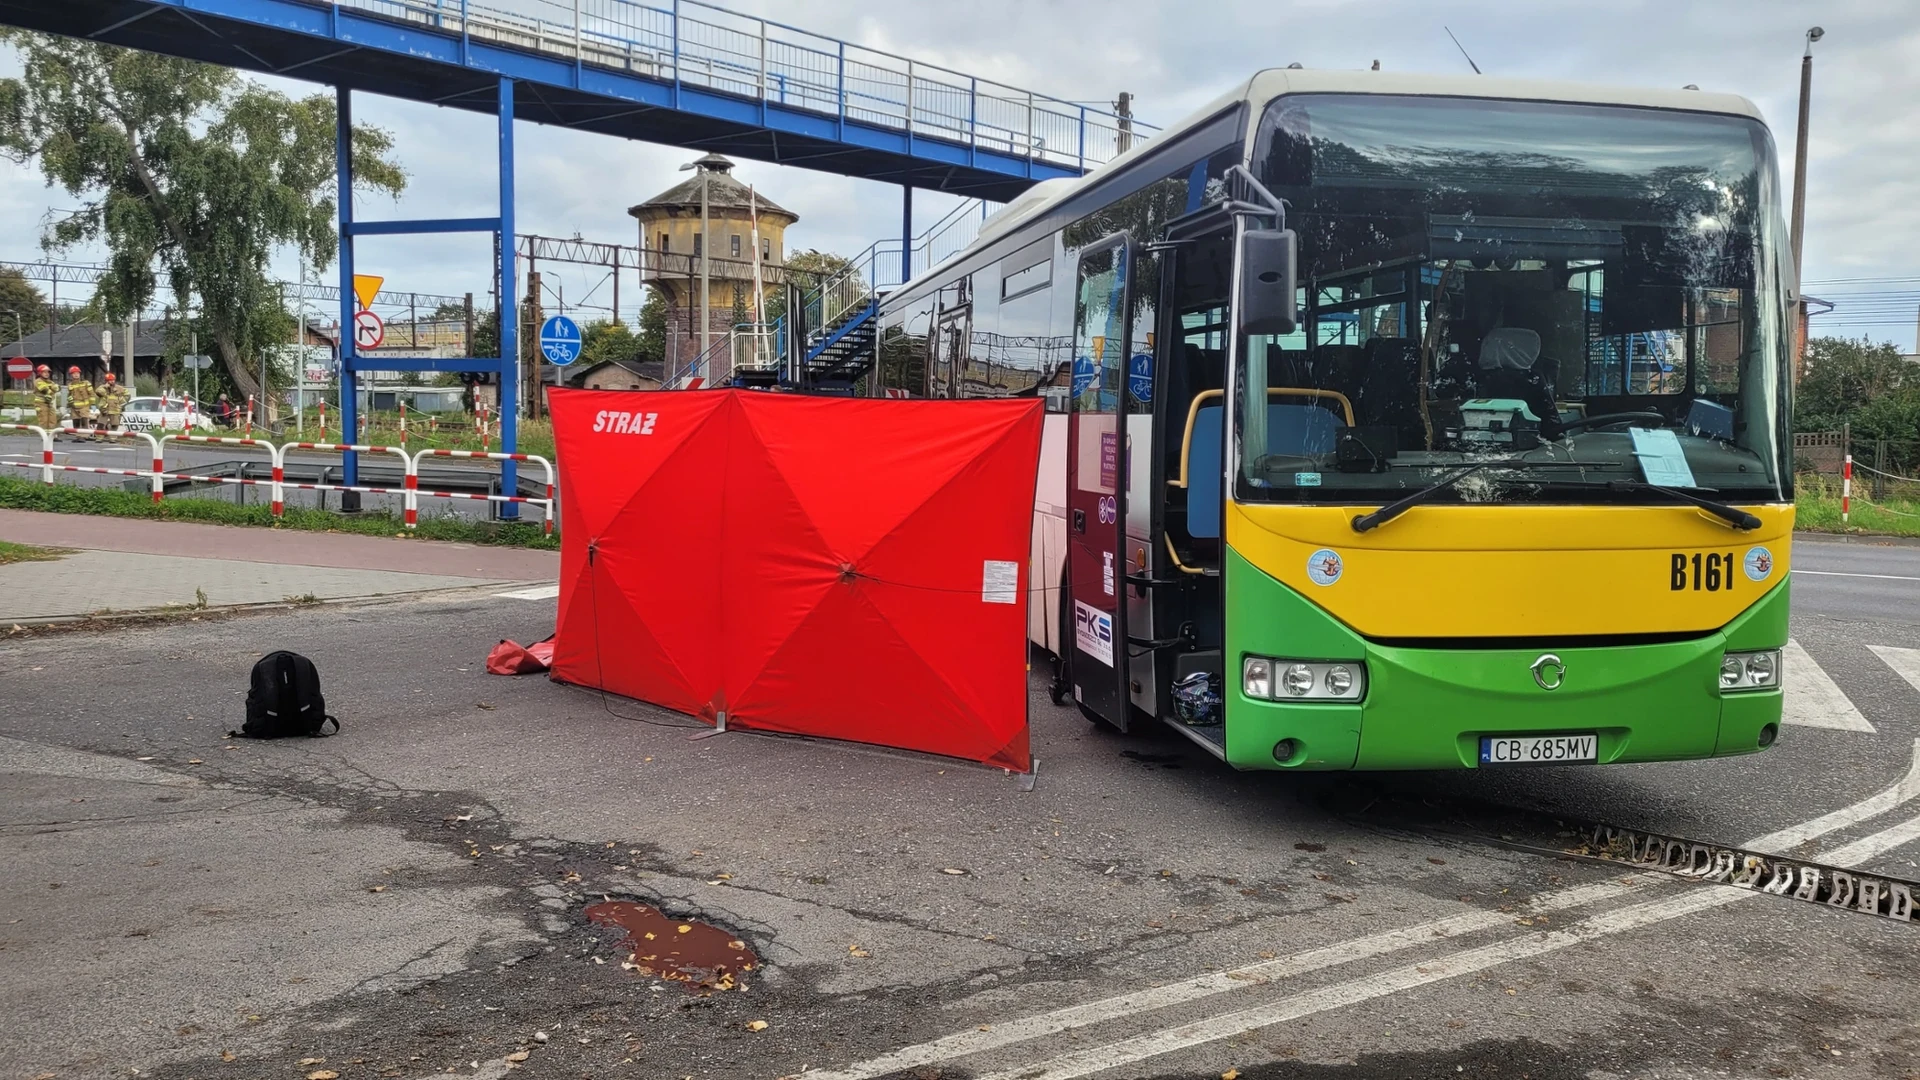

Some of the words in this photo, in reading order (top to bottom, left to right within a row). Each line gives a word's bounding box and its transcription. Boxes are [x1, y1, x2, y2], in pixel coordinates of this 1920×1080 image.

[1670, 553, 1734, 592] B161
[1077, 605, 1111, 643] PKS
[1496, 740, 1522, 761] CB
[1530, 738, 1592, 760] 685MV
